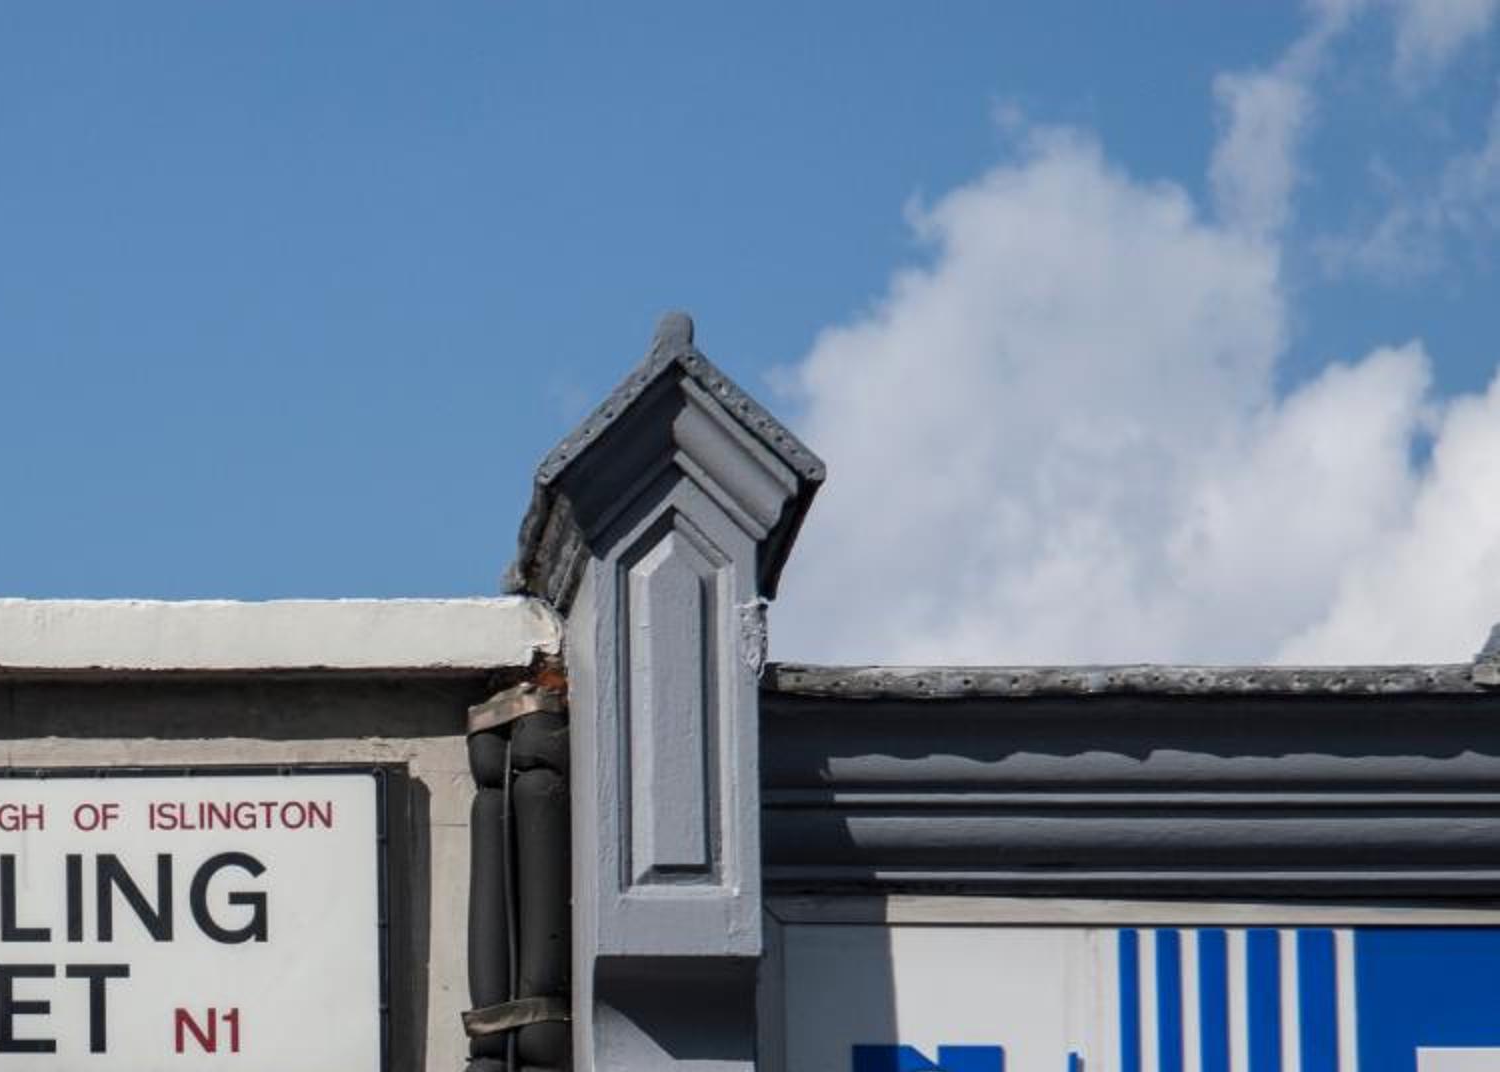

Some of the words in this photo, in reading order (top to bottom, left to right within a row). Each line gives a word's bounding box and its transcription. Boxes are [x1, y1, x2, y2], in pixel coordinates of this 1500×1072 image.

[73, 802, 120, 832] OF
[147, 801, 334, 831] ISLINGTON
[173, 1007, 241, 1053] N1
